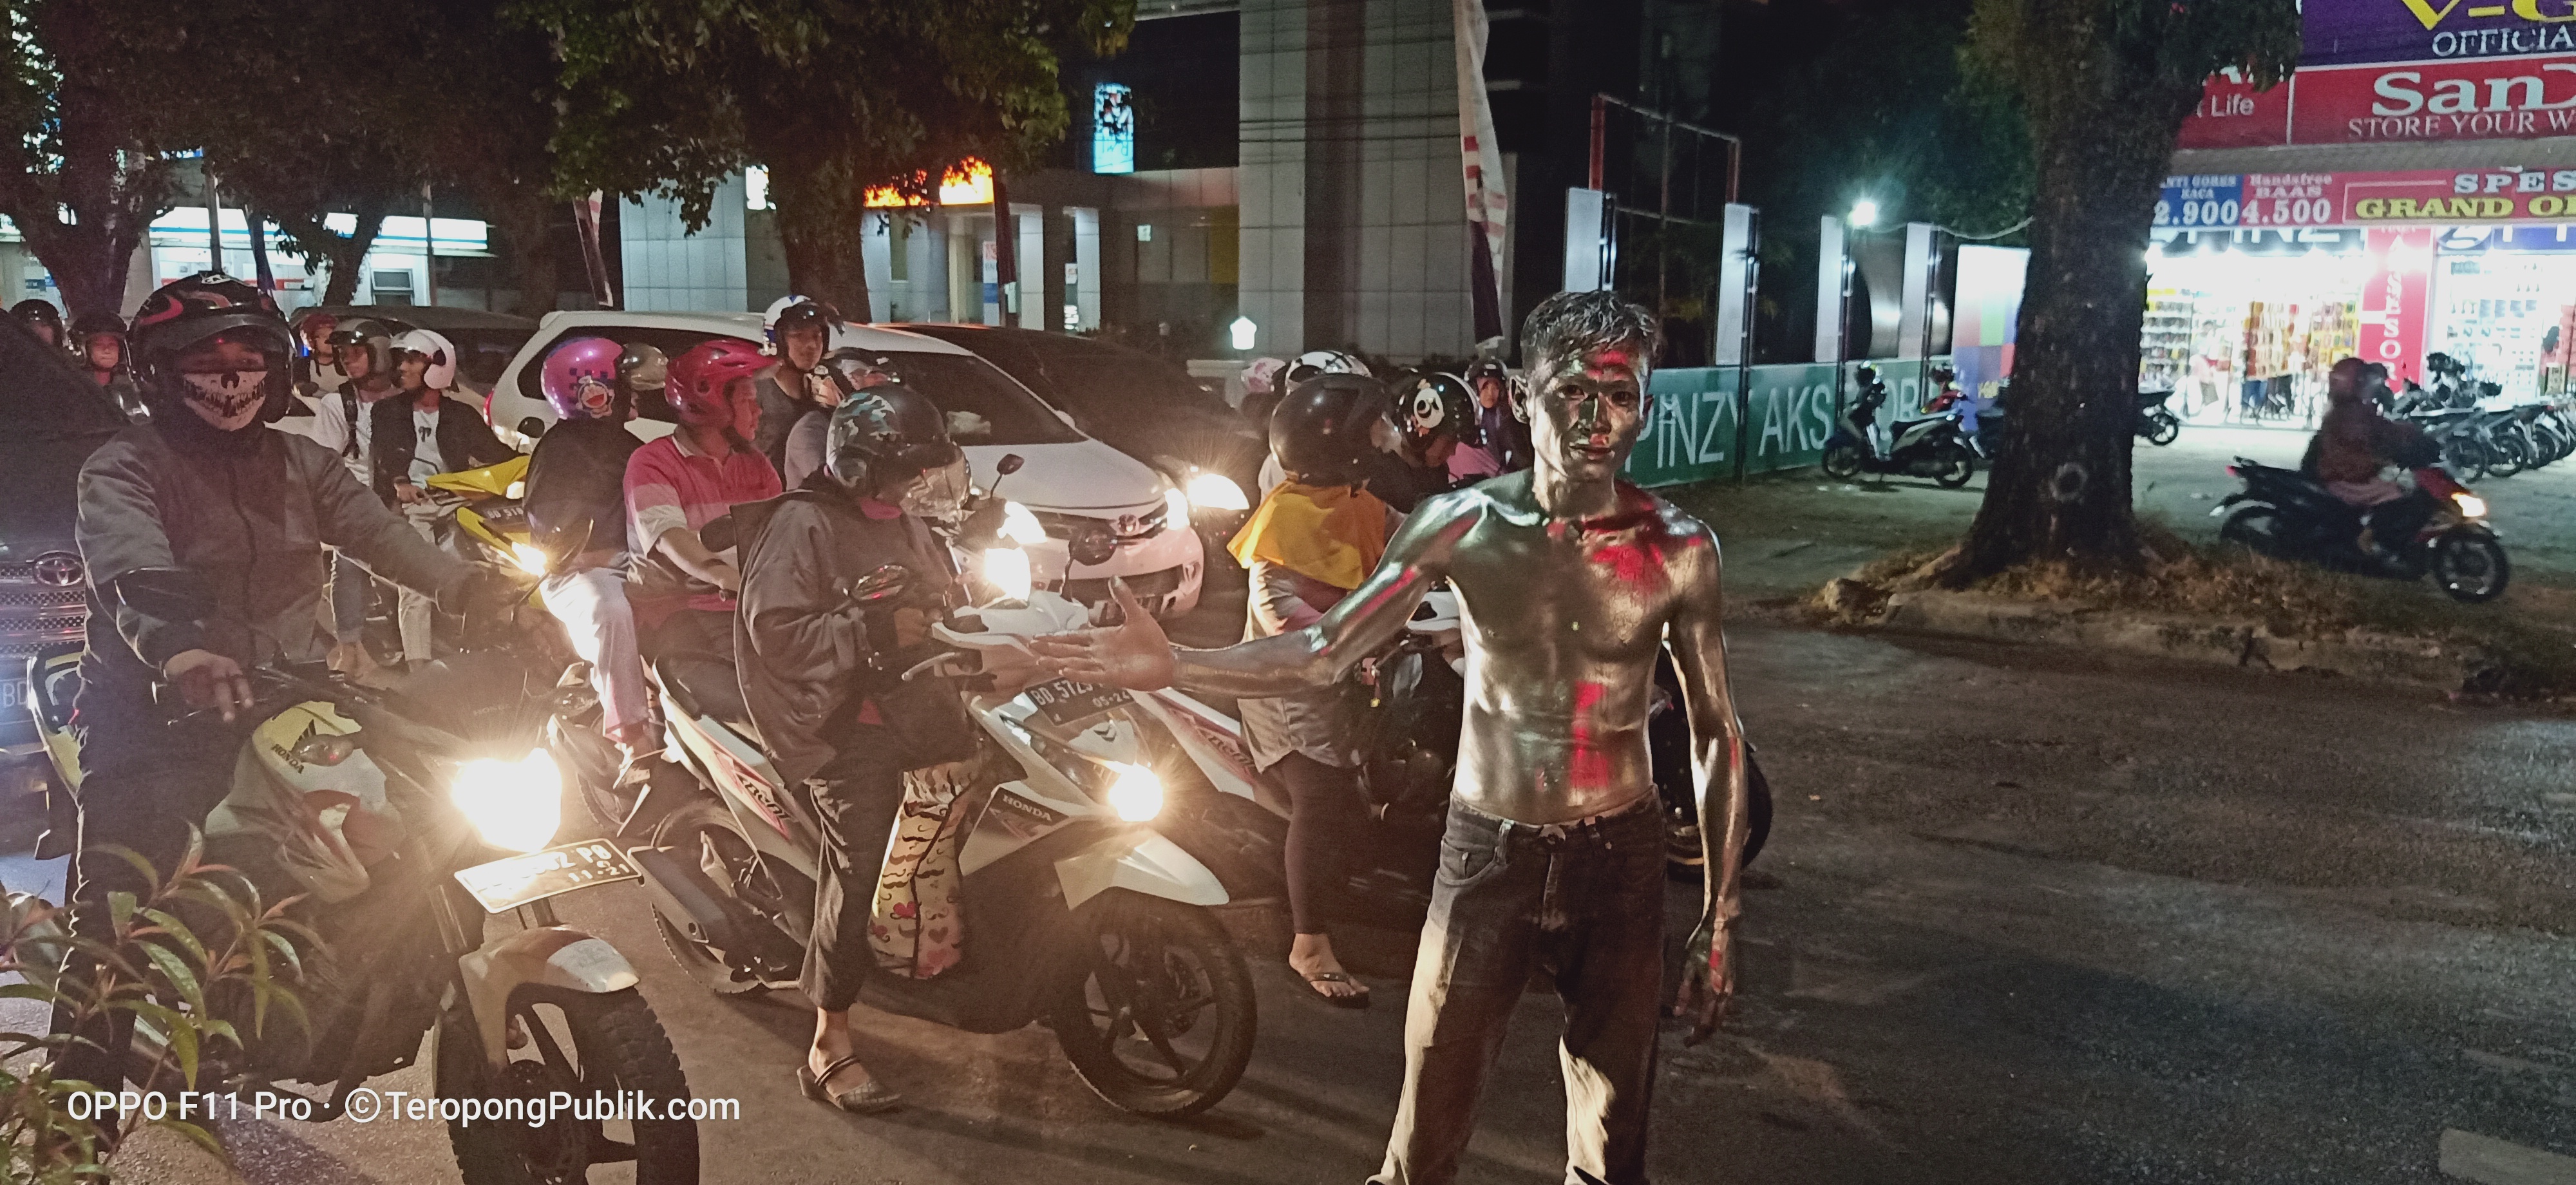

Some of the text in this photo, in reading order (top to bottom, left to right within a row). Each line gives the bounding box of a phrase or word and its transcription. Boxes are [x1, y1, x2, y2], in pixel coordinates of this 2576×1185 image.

[2211, 93, 2254, 117] Life
[2348, 115, 2441, 140] STORE
[2451, 111, 2535, 135] YOUR
[2241, 198, 2331, 225] 4.500
[2355, 196, 2514, 219] GRAND
[1030, 687, 1055, 706] BD
[271, 743, 305, 775] HONDA
[1002, 794, 1052, 822] HONDA
